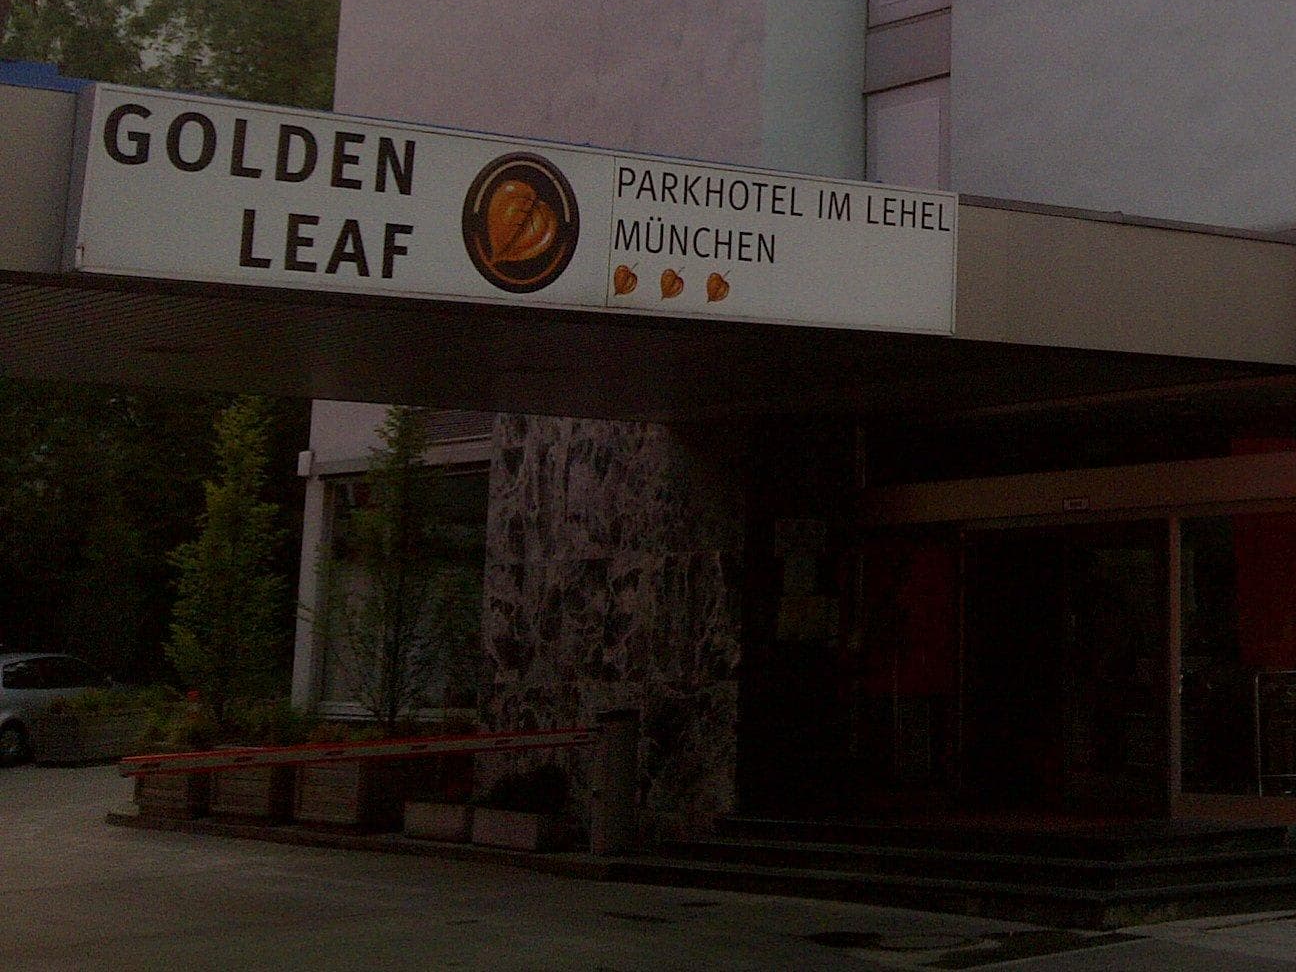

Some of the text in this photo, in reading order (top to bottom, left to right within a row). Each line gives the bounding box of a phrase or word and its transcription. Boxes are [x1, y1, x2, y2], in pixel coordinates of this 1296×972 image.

[103, 103, 416, 196] GOLDEN
[617, 166, 951, 232] PARKHOTEL IM LEHEL
[239, 209, 414, 279] LEAF
[613, 217, 776, 264] MÜNCHEN
